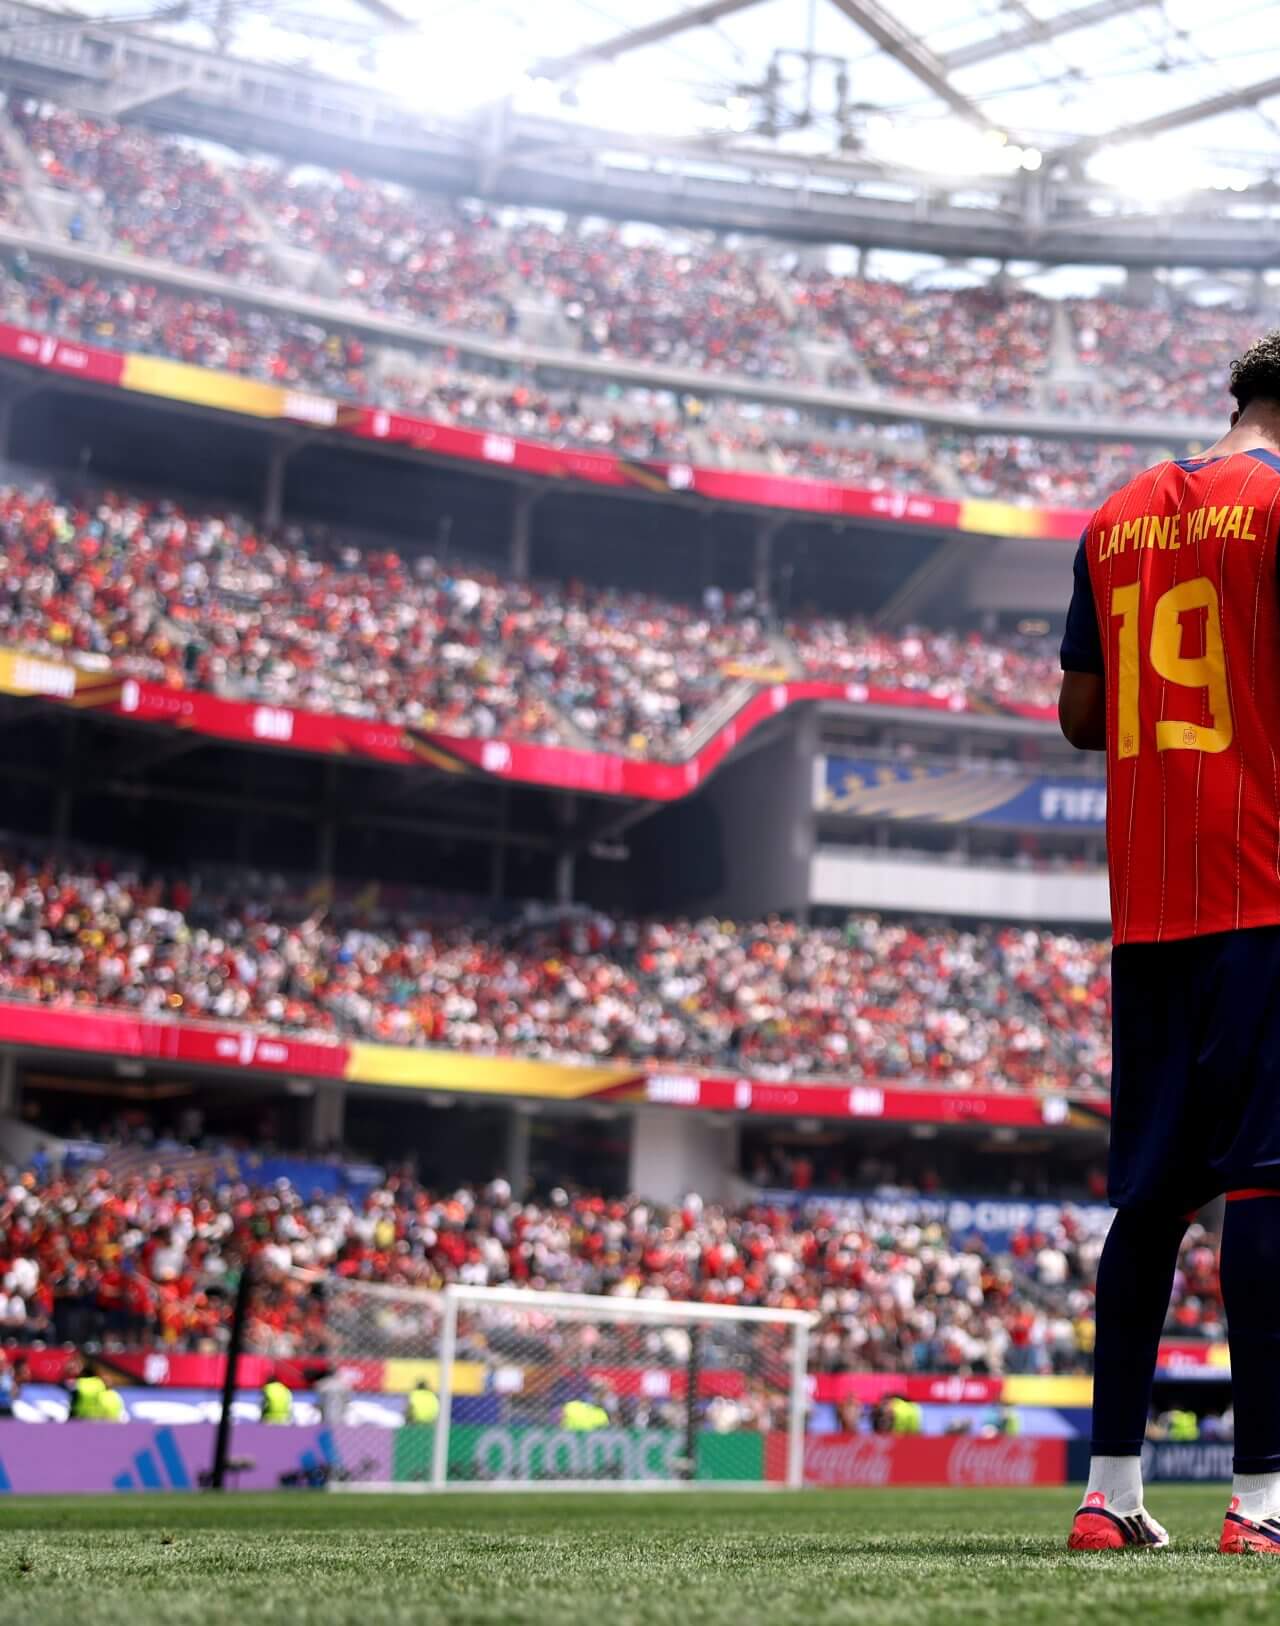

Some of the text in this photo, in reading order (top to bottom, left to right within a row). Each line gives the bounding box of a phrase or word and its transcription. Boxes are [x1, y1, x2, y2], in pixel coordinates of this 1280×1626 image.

[1098, 504, 1257, 563] LAMINE YAMAL
[1111, 576, 1233, 760] 19
